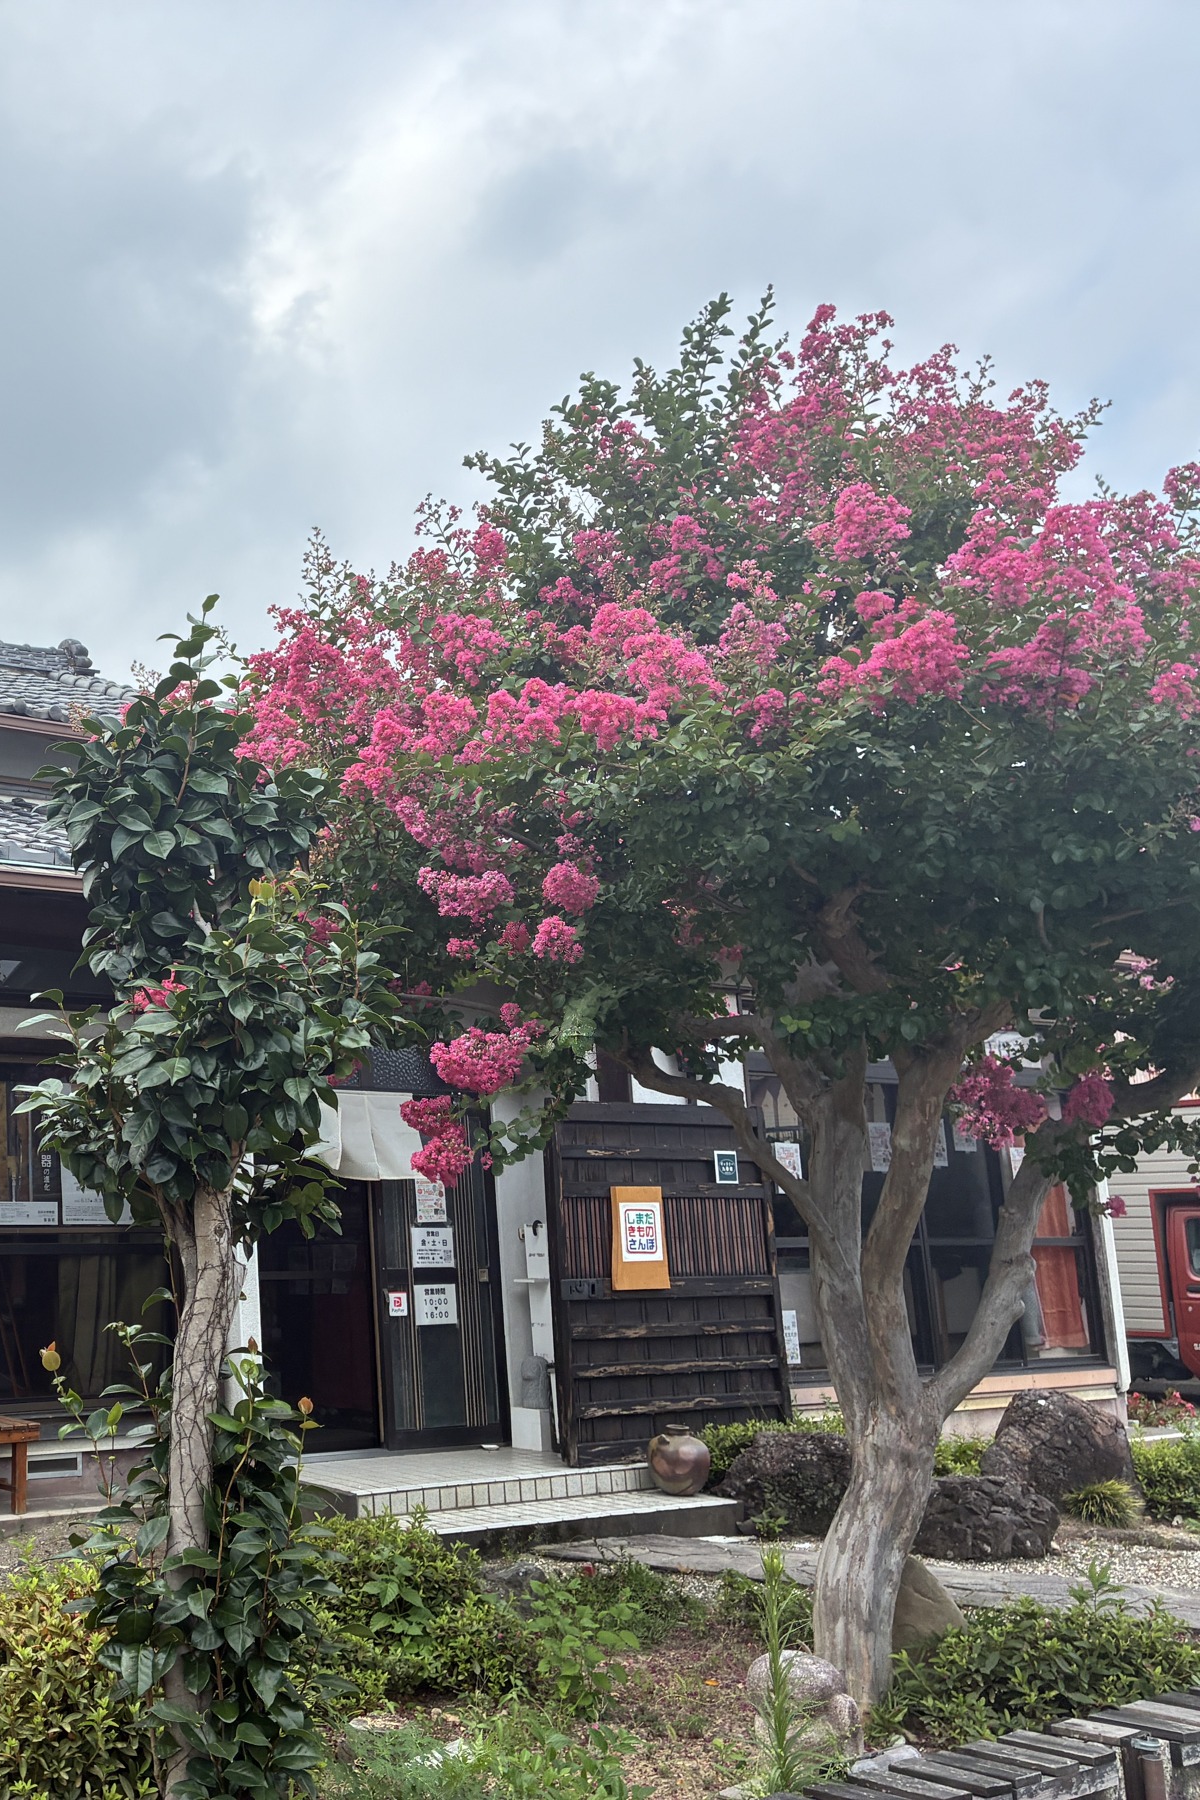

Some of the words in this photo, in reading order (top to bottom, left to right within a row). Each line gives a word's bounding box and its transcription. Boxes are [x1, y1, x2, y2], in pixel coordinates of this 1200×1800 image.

[627, 1212, 653, 1225] しまだ
[628, 1226, 655, 1238] きもの
[424, 1288, 446, 1296] 営業時間
[424, 1298, 449, 1306] 10:00
[425, 1311, 450, 1319] 16:00
